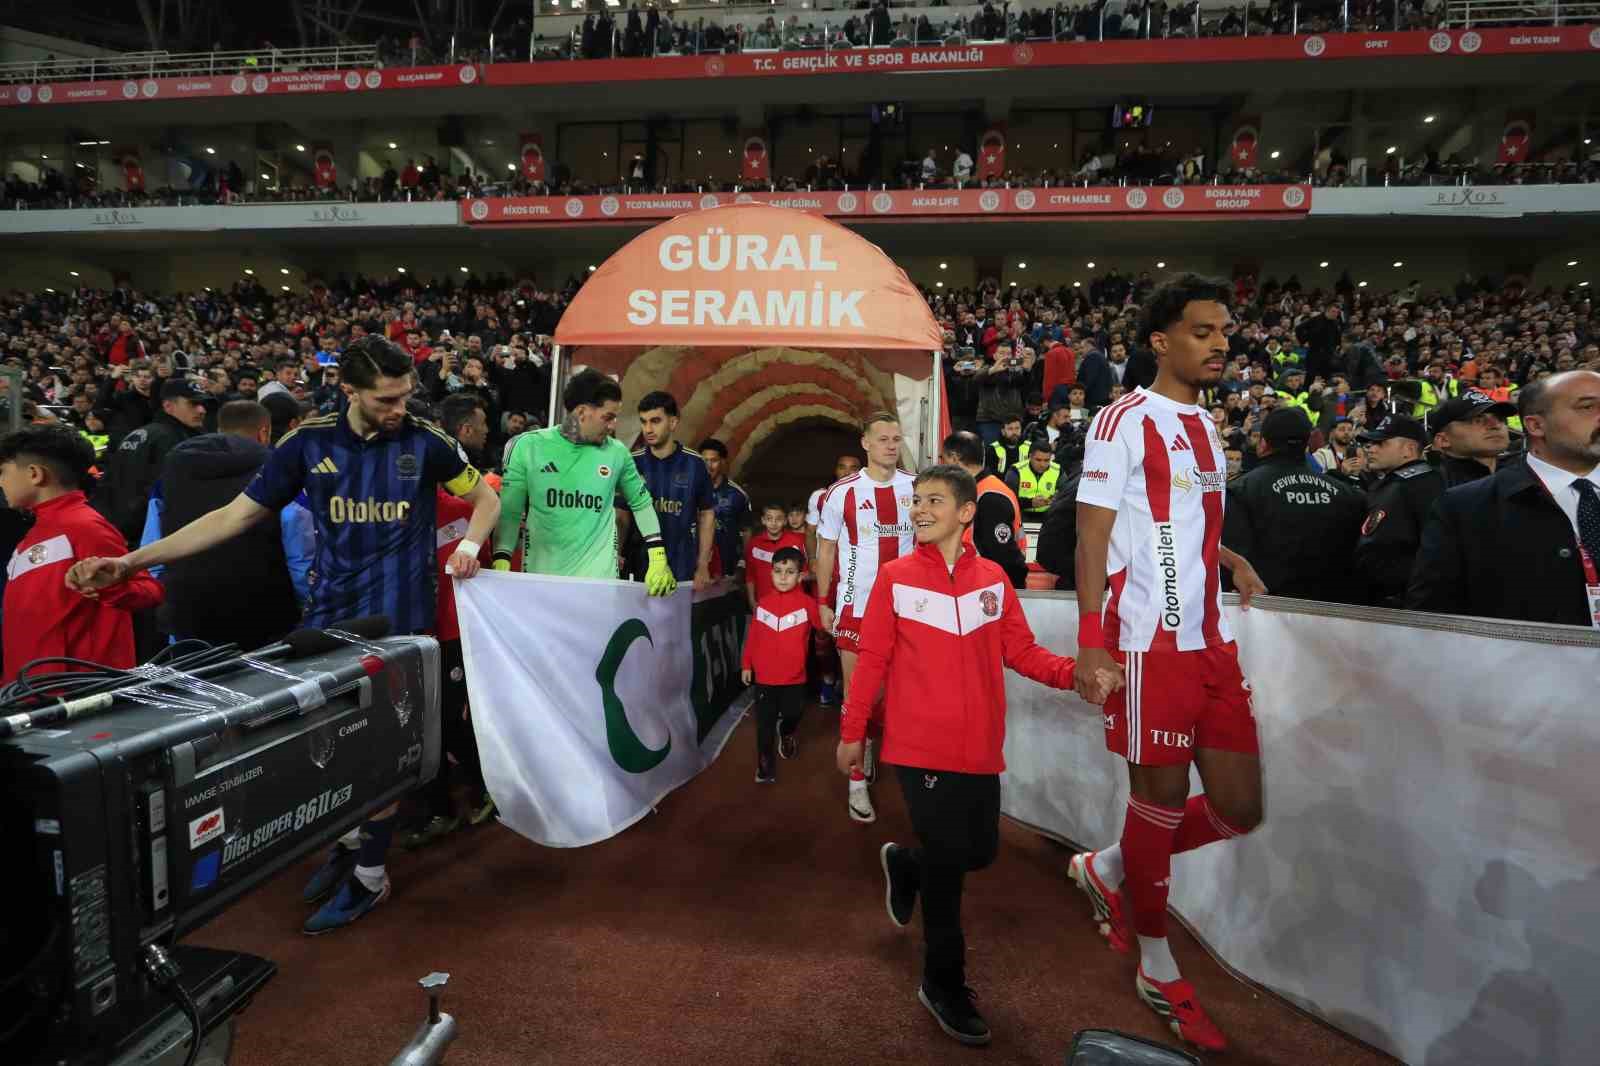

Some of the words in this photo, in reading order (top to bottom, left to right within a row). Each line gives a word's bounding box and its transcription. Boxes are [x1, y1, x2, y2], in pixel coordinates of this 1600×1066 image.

[753, 58, 776, 71] T.C.
[783, 55, 838, 72] GENÇLİK
[845, 55, 863, 67] VE
[868, 53, 904, 66] SPOR
[911, 48, 984, 64] BAKANLIĞI
[912, 197, 938, 206] AKAR
[939, 196, 960, 205] LIFE
[1206, 189, 1233, 198] BORA
[1234, 188, 1261, 198] PARK
[1216, 200, 1250, 208] GROUP
[658, 227, 838, 273] GÜRAL
[626, 281, 866, 328] SERAMİK
[1299, 474, 1339, 495] KUVVET
[546, 488, 603, 512] Otokoç
[843, 547, 857, 603] Otomobilen
[1157, 524, 1181, 627] Otomobilen
[339, 718, 368, 736] Canon
[1150, 726, 1196, 748] TUR
[222, 832, 251, 865] DIGI
[252, 811, 293, 848] SUPER
